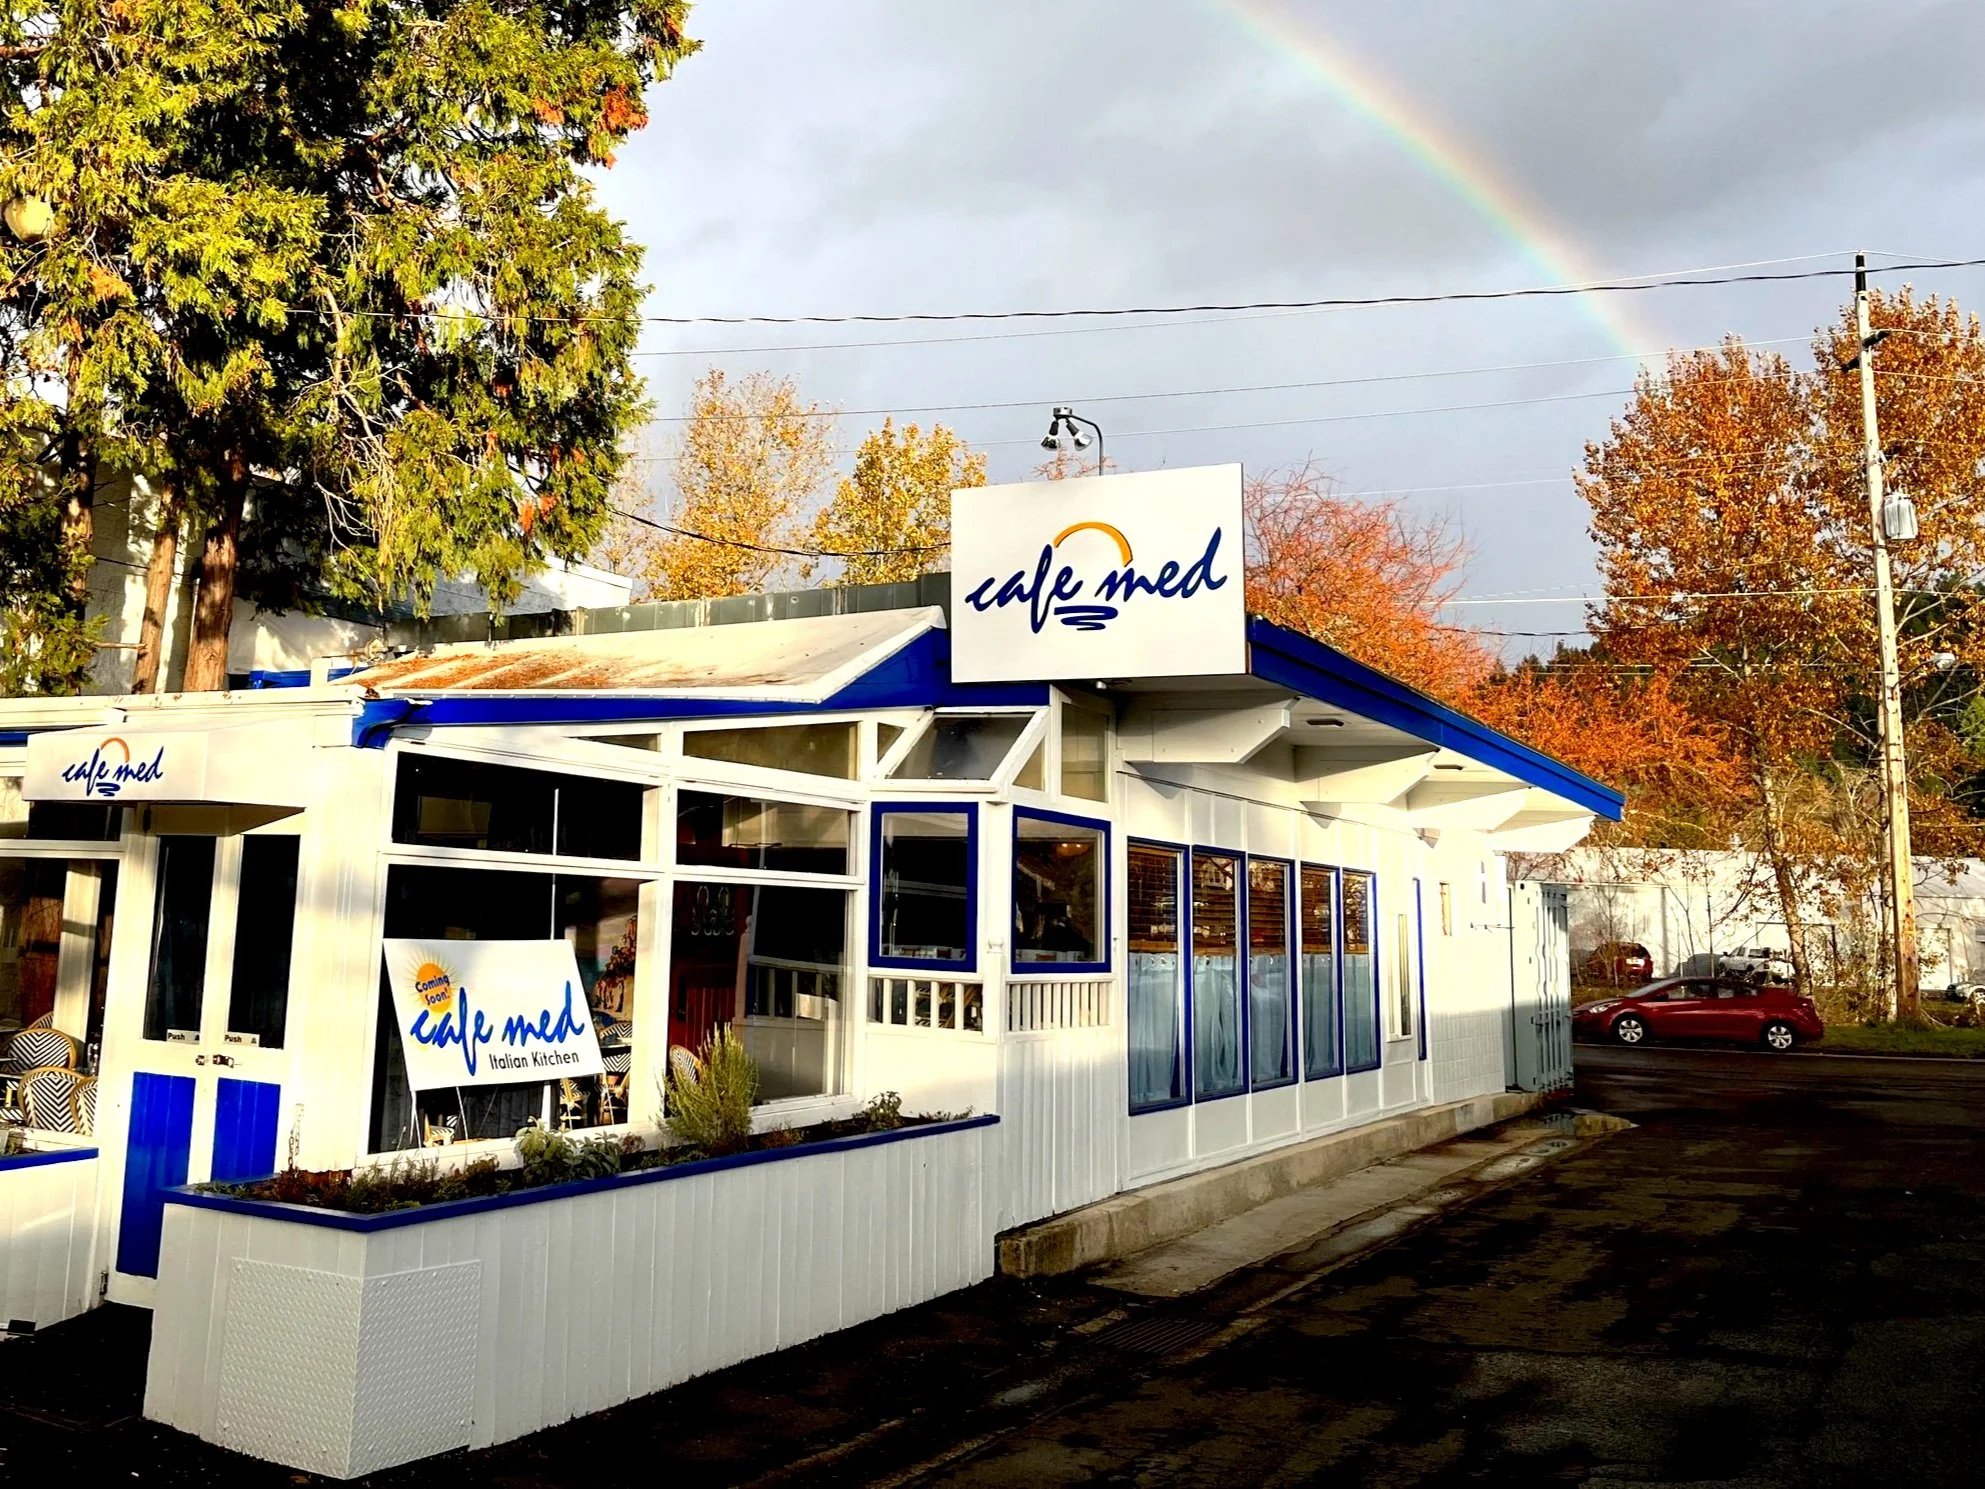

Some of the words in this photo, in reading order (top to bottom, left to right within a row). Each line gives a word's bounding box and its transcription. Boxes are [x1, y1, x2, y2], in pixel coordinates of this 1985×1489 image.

[964, 543, 1083, 634] cafe
[1094, 526, 1228, 603] med
[61, 747, 110, 797] cafe
[112, 745, 164, 783] med
[414, 973, 451, 993] Coming
[424, 987, 451, 1006] Soon!
[167, 1032, 186, 1041] Push
[224, 1034, 242, 1043] Push
[409, 986, 494, 1077] cafe
[501, 980, 585, 1047] med
[489, 1053, 529, 1071] Italian
[531, 1050, 580, 1068] Kitchen
